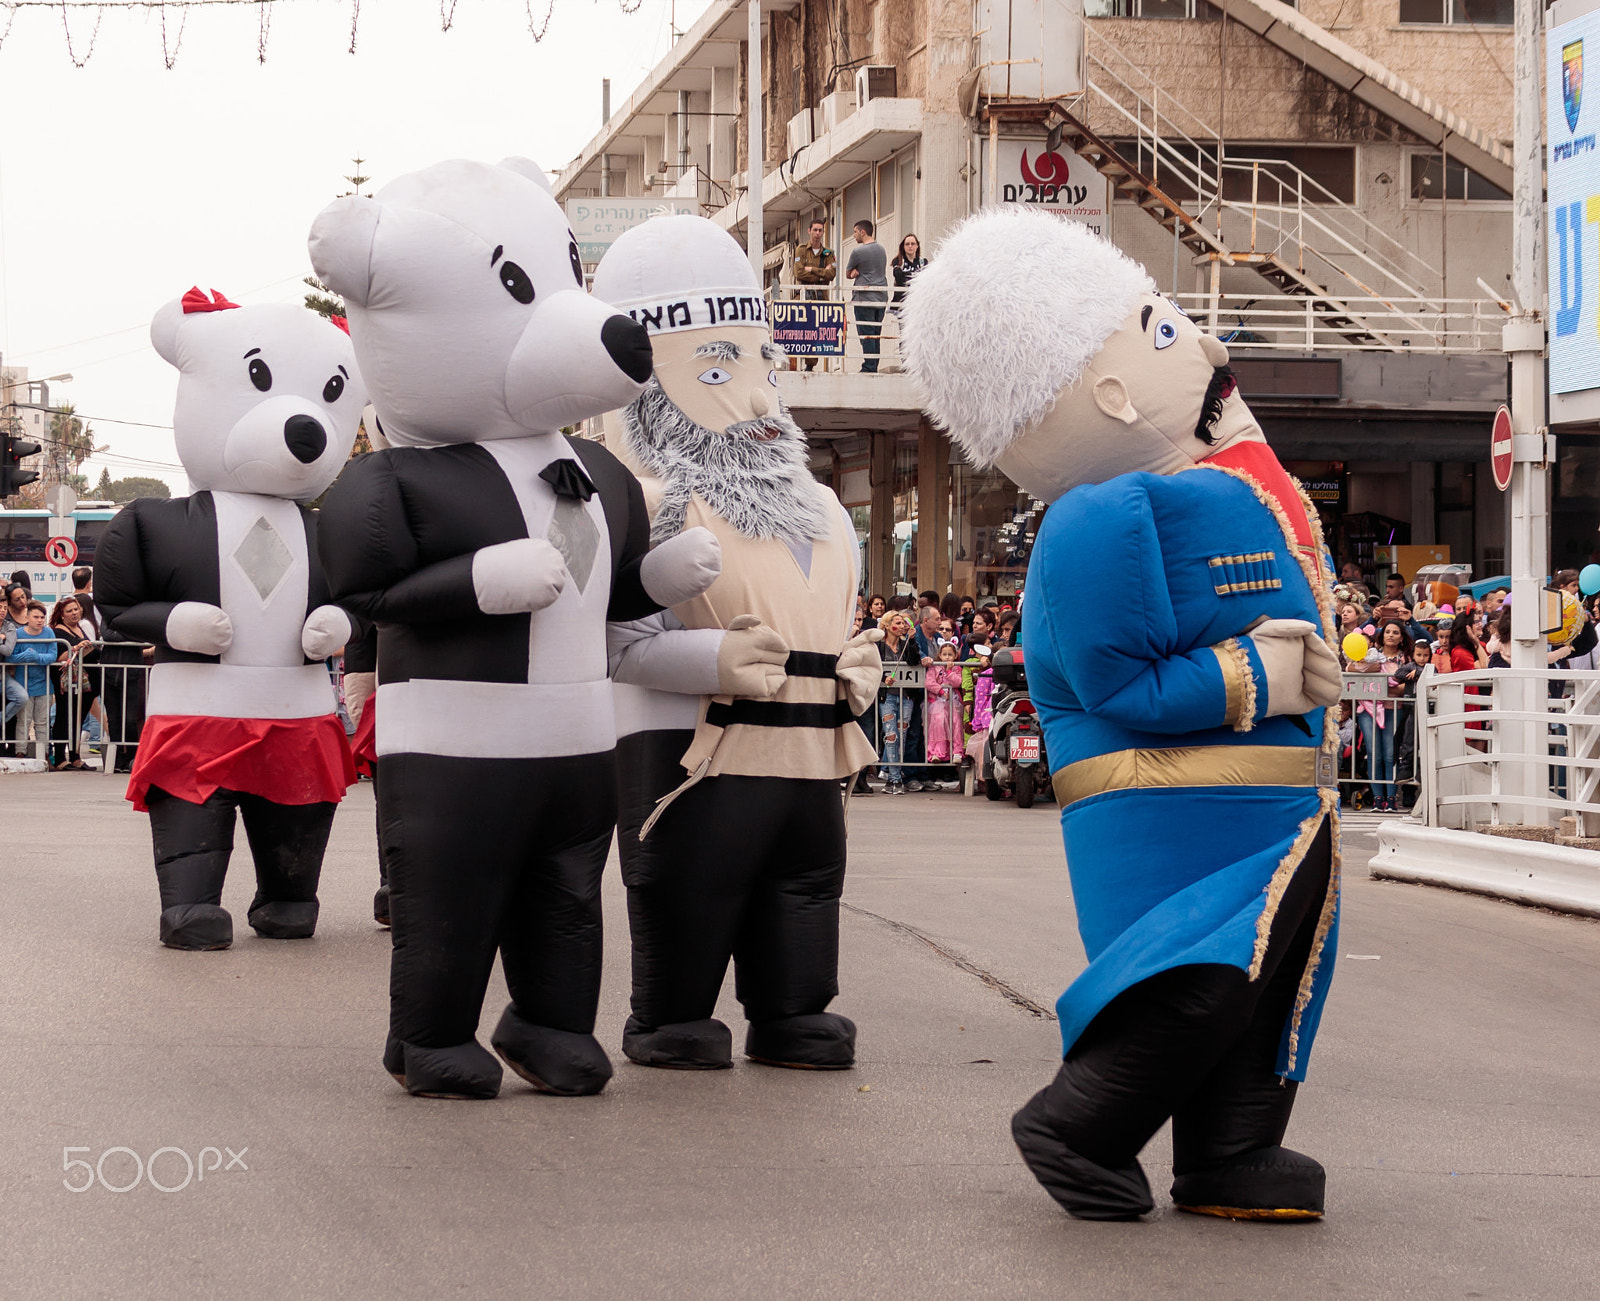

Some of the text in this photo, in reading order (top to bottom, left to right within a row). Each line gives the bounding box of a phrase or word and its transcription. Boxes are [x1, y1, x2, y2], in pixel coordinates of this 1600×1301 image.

[1003, 184, 1088, 206] ערבובים
[774, 304, 808, 323] ברוש
[811, 305, 844, 328] תיווך
[819, 327, 837, 341] БРОШ
